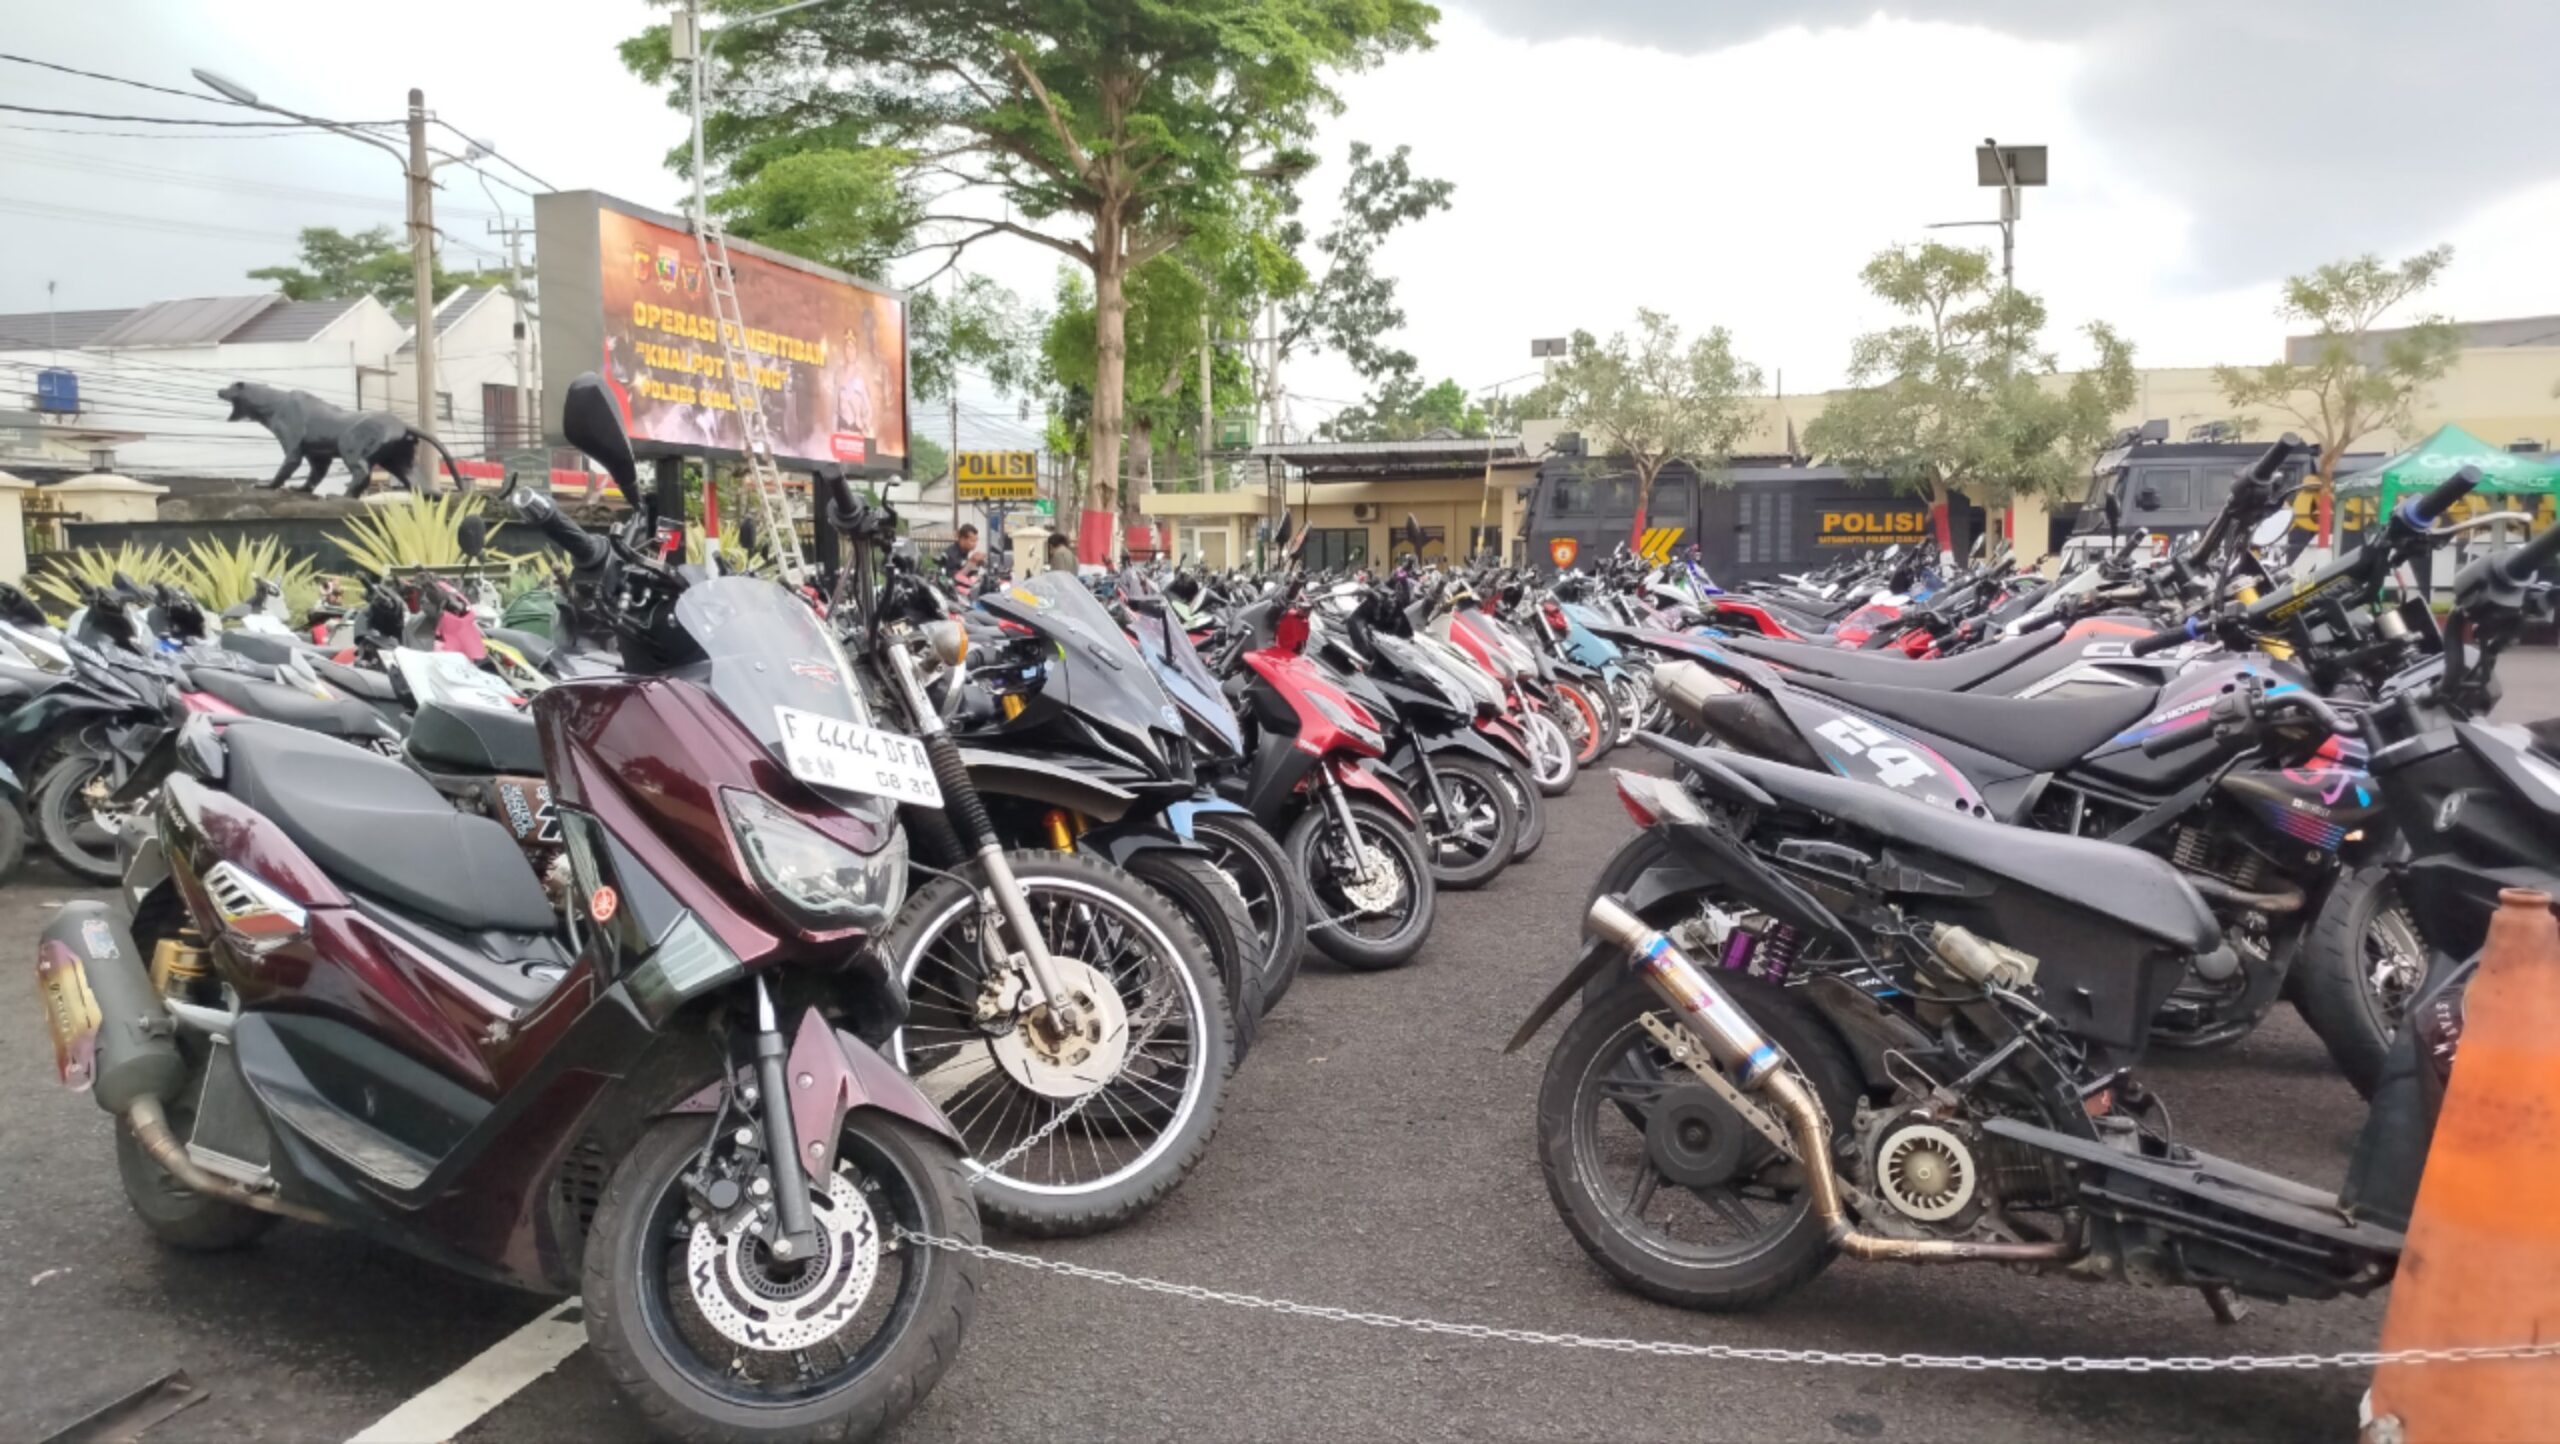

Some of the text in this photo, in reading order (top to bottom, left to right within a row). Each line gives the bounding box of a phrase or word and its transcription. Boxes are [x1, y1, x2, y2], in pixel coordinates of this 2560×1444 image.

[632, 301, 718, 344] OPERASI
[957, 454, 1034, 475] POLISI
[1822, 512, 1924, 533] POLISI
[784, 713, 796, 739] F
[816, 721, 878, 759] 4444
